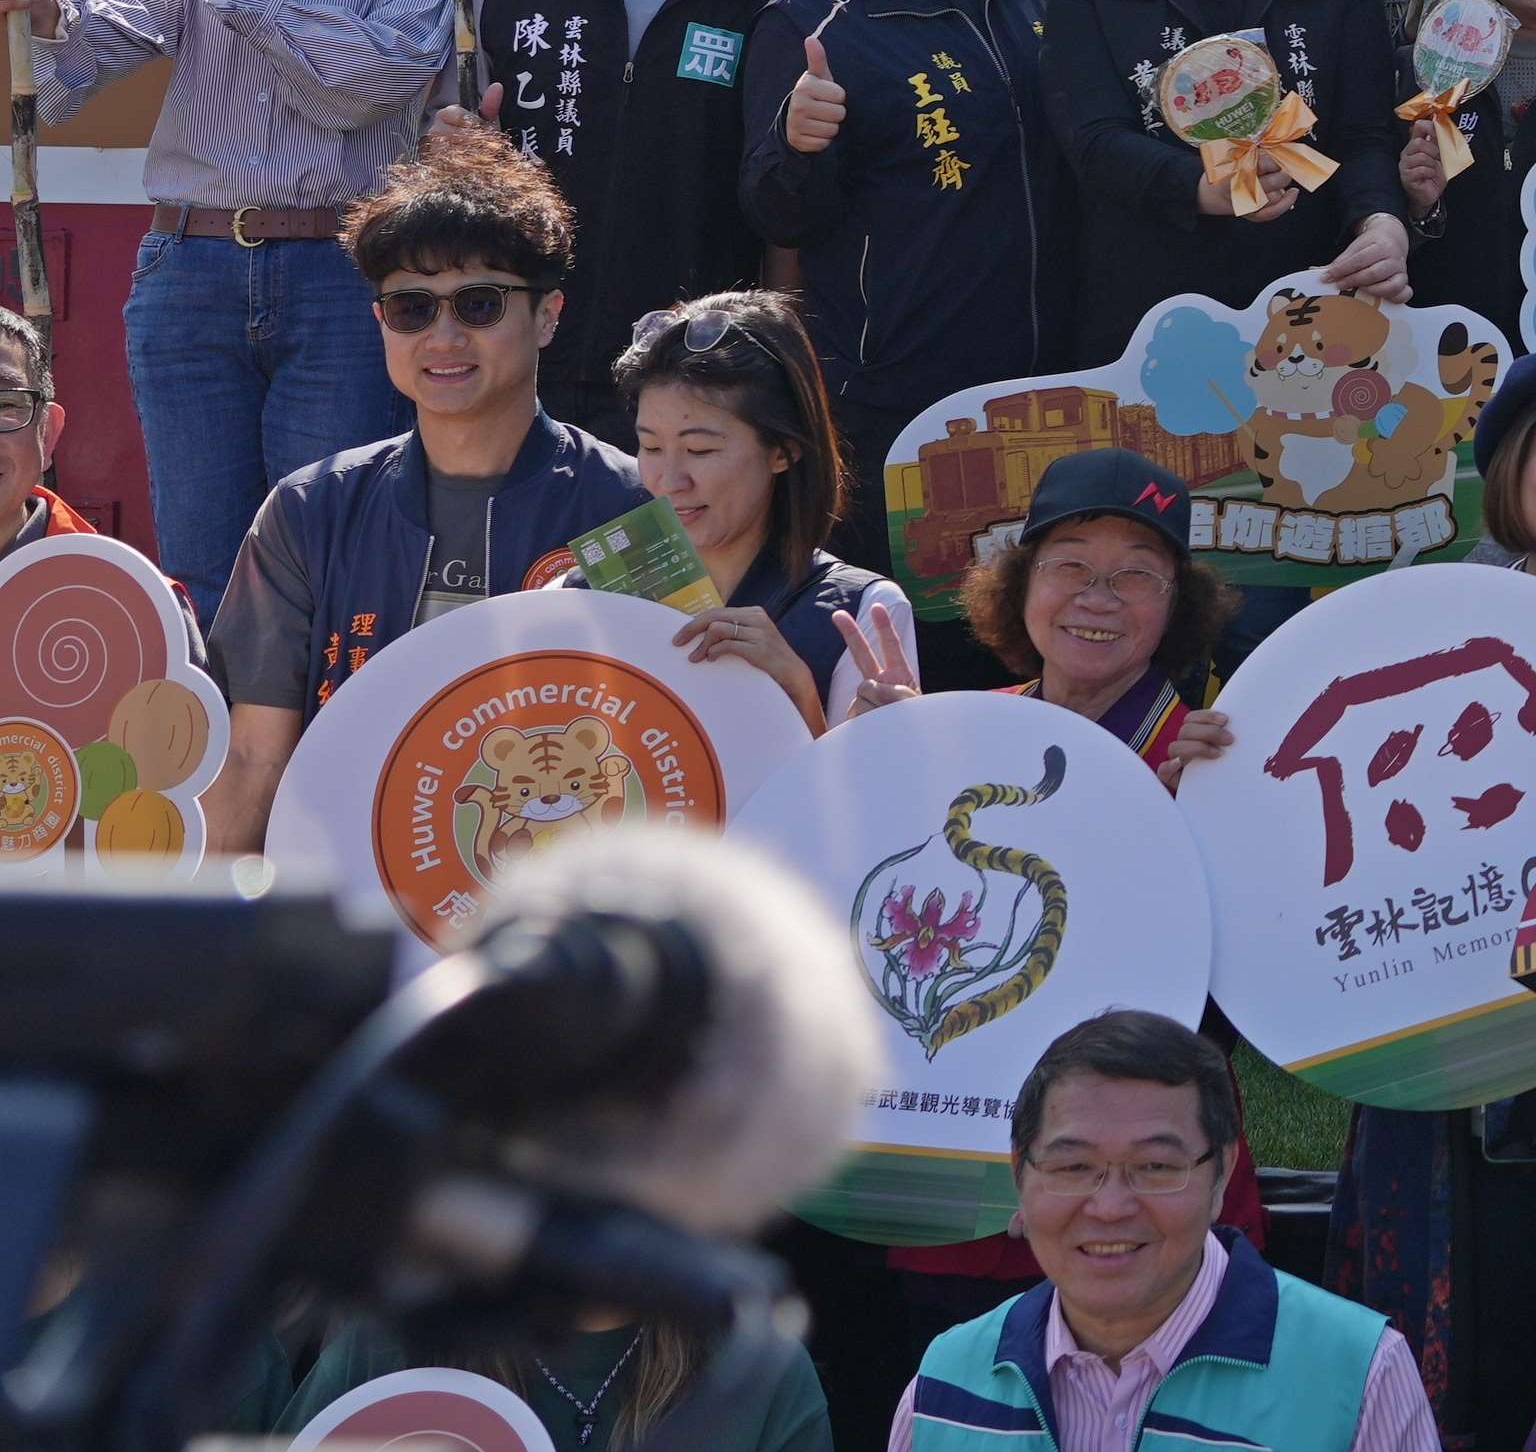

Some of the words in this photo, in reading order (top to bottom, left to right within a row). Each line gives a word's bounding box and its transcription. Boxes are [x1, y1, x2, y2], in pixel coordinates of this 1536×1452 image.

[554, 15, 589, 157] 雲林縣議員
[931, 50, 973, 94] 議員
[907, 72, 973, 191] 王鈺齊
[1214, 101, 1255, 129] HUWEI
[47, 754, 64, 805] district
[410, 761, 445, 873] Huwei
[442, 682, 638, 752] commercial
[1333, 957, 1415, 993] Yunlin
[1432, 925, 1522, 965] Memor
